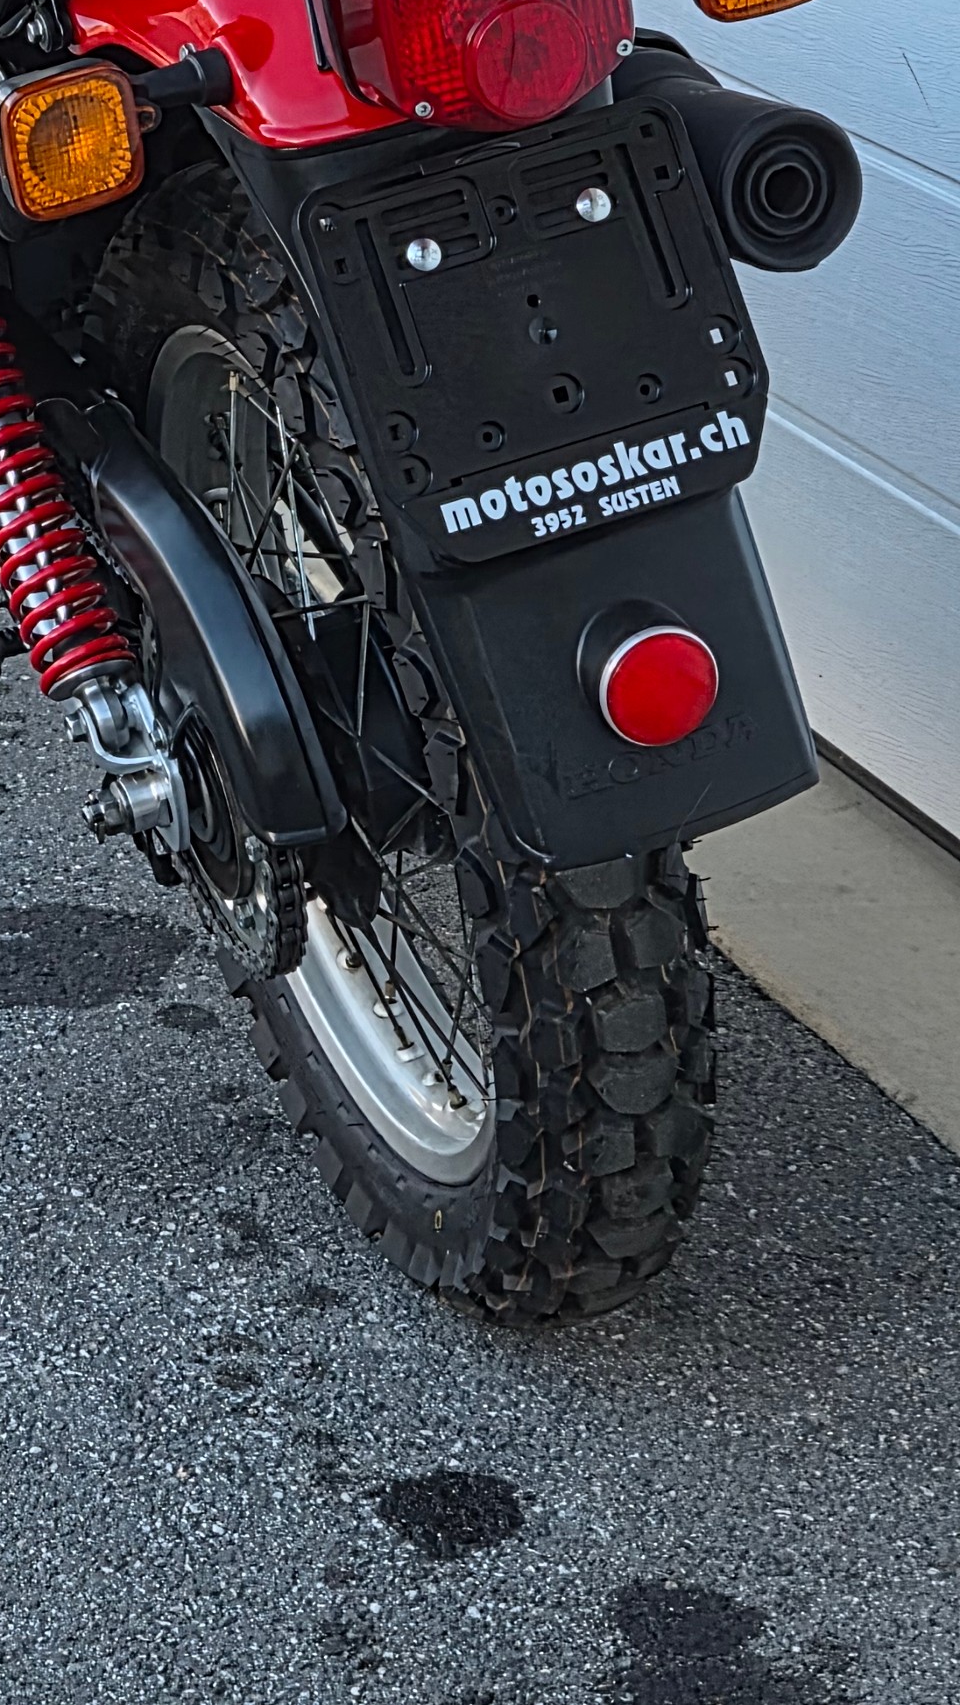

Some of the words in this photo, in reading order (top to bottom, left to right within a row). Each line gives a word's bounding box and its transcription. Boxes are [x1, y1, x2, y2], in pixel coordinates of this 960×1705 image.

[439, 410, 751, 534] motososkar.ch
[530, 504, 587, 537] 3952
[598, 475, 681, 517] SUSTEN
